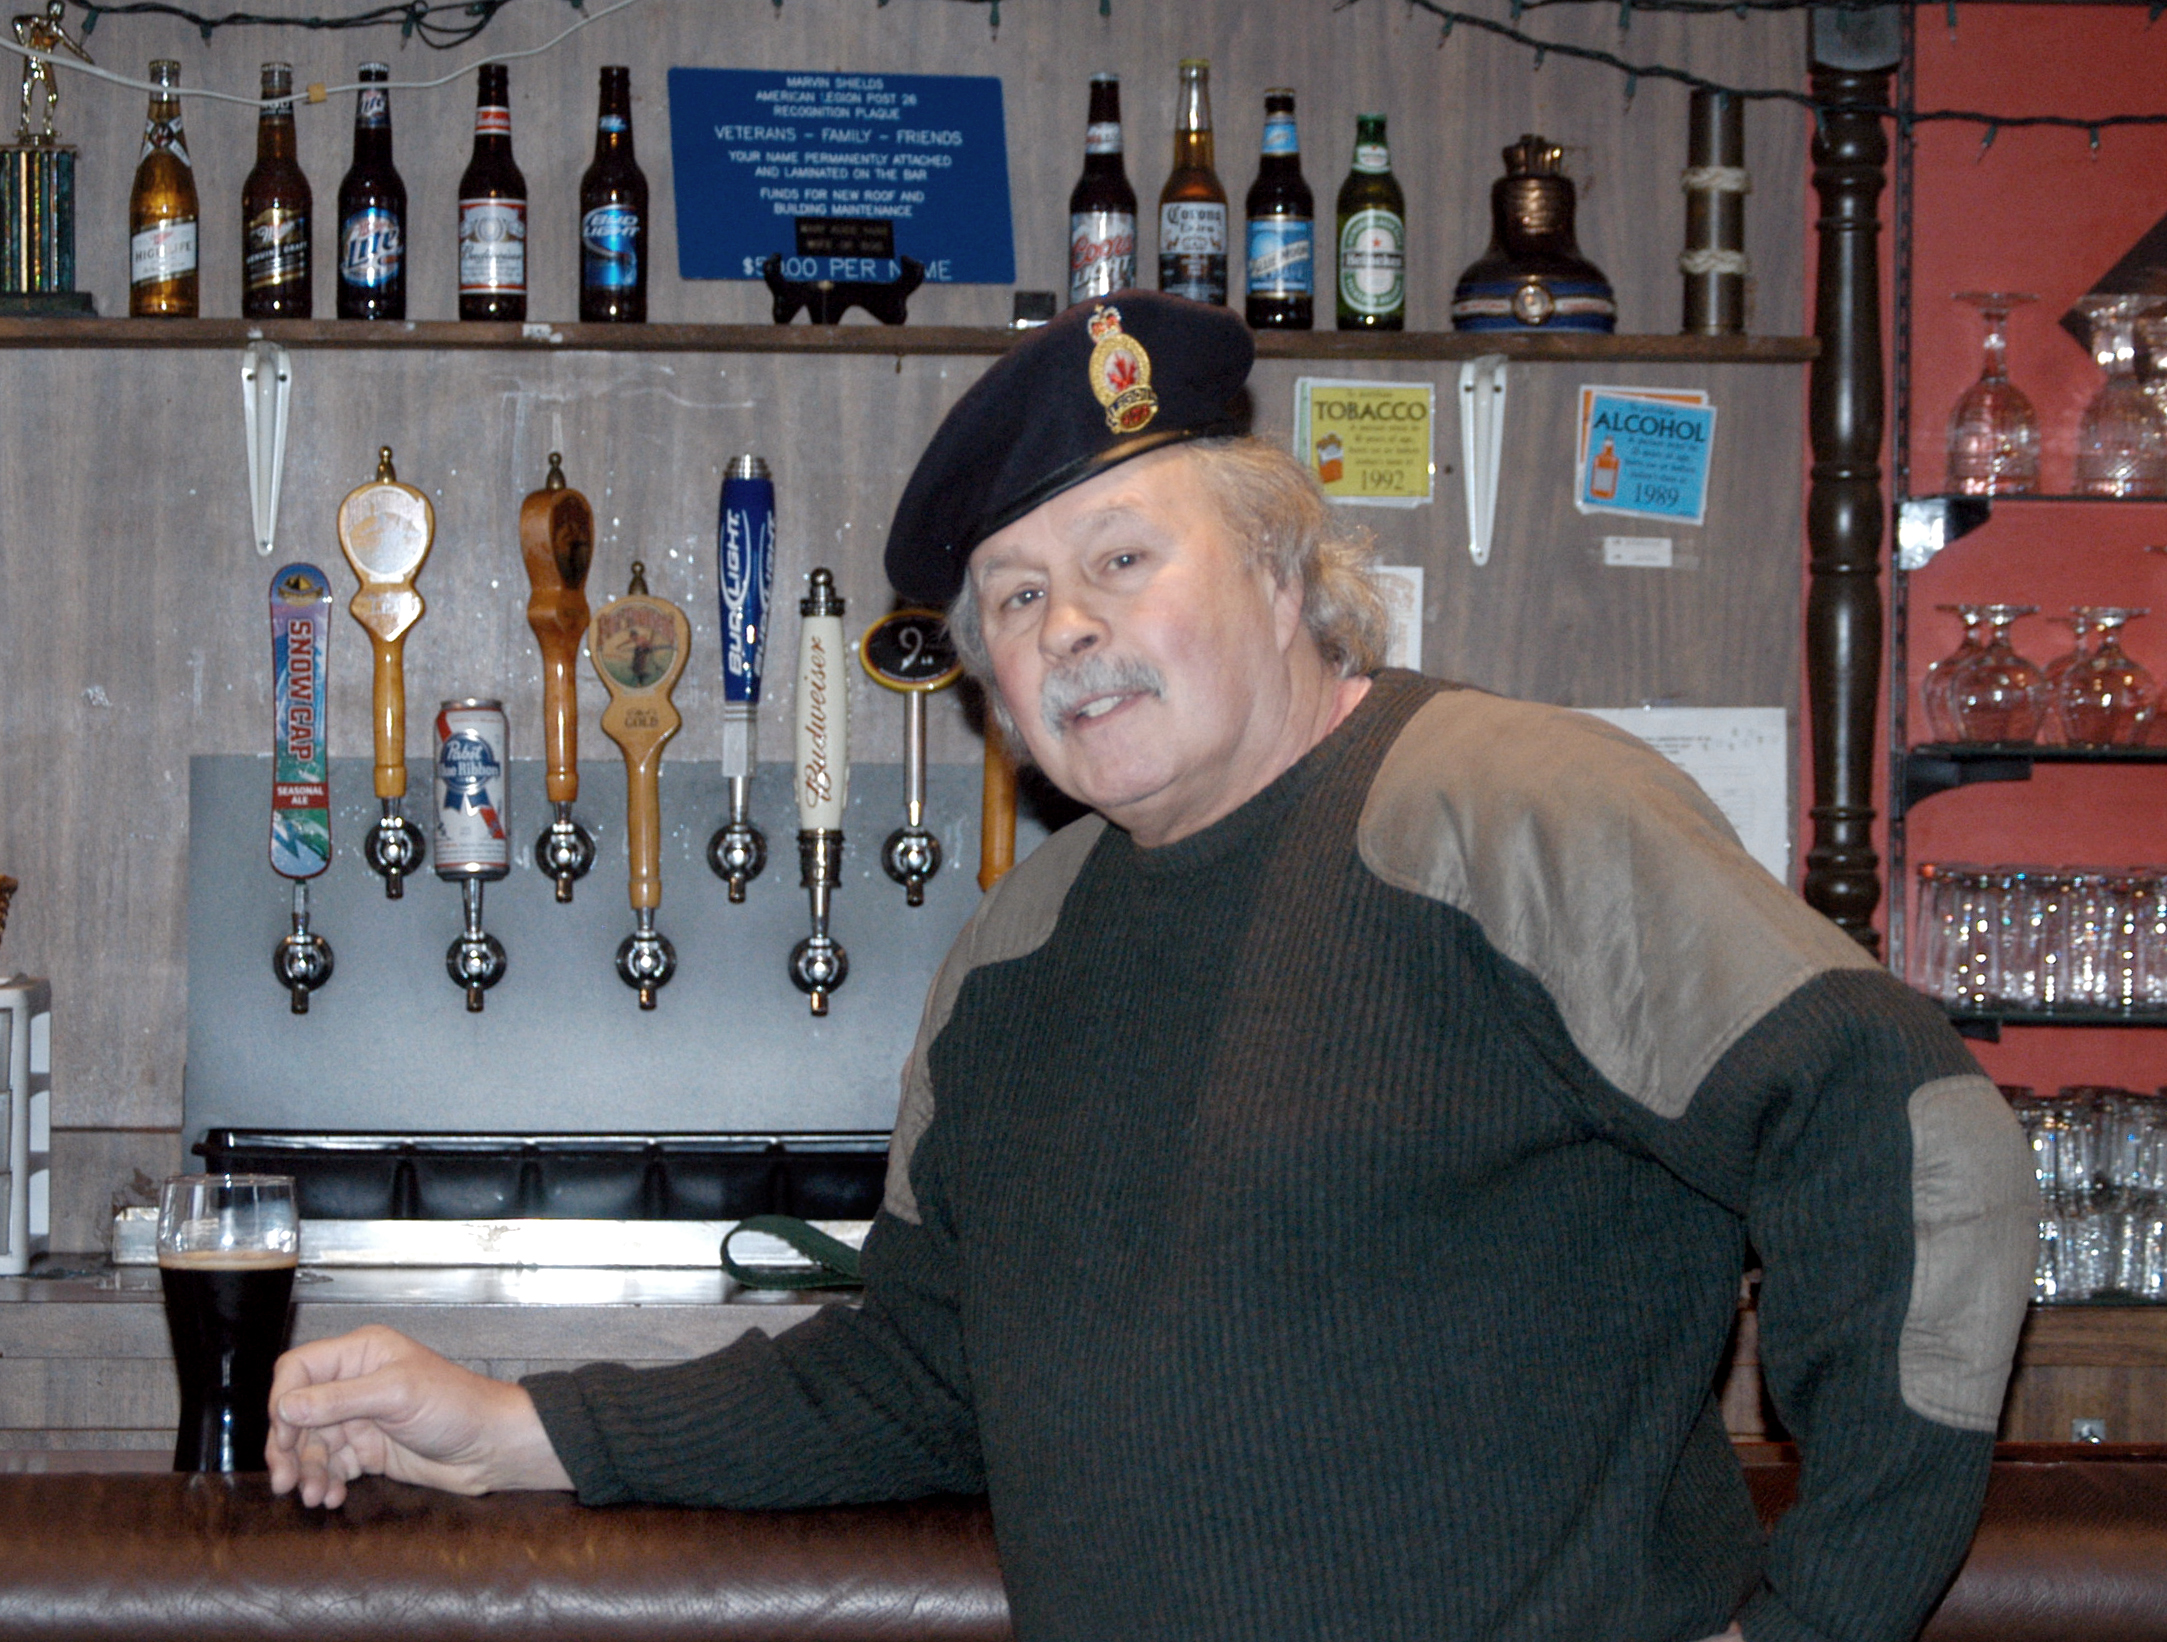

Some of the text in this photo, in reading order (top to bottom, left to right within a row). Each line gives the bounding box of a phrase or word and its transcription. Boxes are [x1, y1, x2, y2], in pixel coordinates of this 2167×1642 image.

[786, 76, 884, 90] MARVIN SHIELDS
[755, 89, 816, 102] AMERICAN
[820, 91, 862, 104] LEGION
[866, 92, 896, 105] POST
[773, 104, 900, 120] RECOGNITION PLAQUE
[714, 125, 797, 141] VETERANS
[821, 127, 872, 143] FAMILY
[896, 129, 963, 146] FRIENDS
[728, 150, 952, 168] YOUR NAME PERMANENTLY ATTACHED
[755, 166, 927, 181] AND LAMINATED ON THE BAR
[760, 187, 925, 203] FUNDS FOR NEW ROOF AND
[773, 203, 912, 218] BUILDING MAINTENANCE
[1071, 234, 1134, 270] Coors
[830, 257, 877, 279] PER
[889, 259, 952, 281] NME
[1315, 401, 1428, 421] TOBACCO
[1593, 411, 1706, 443] ALCOHOL
[1361, 469, 1404, 491] 1992
[1635, 482, 1680, 507] 1989
[727, 508, 741, 600] LIGHT
[288, 619, 314, 762] SNOW CAP
[804, 635, 832, 808] Budweiser
[446, 739, 483, 761] Pabst
[458, 761, 499, 777] Ribbon
[277, 786, 324, 797] SEASONAL
[290, 796, 308, 806] ALE
